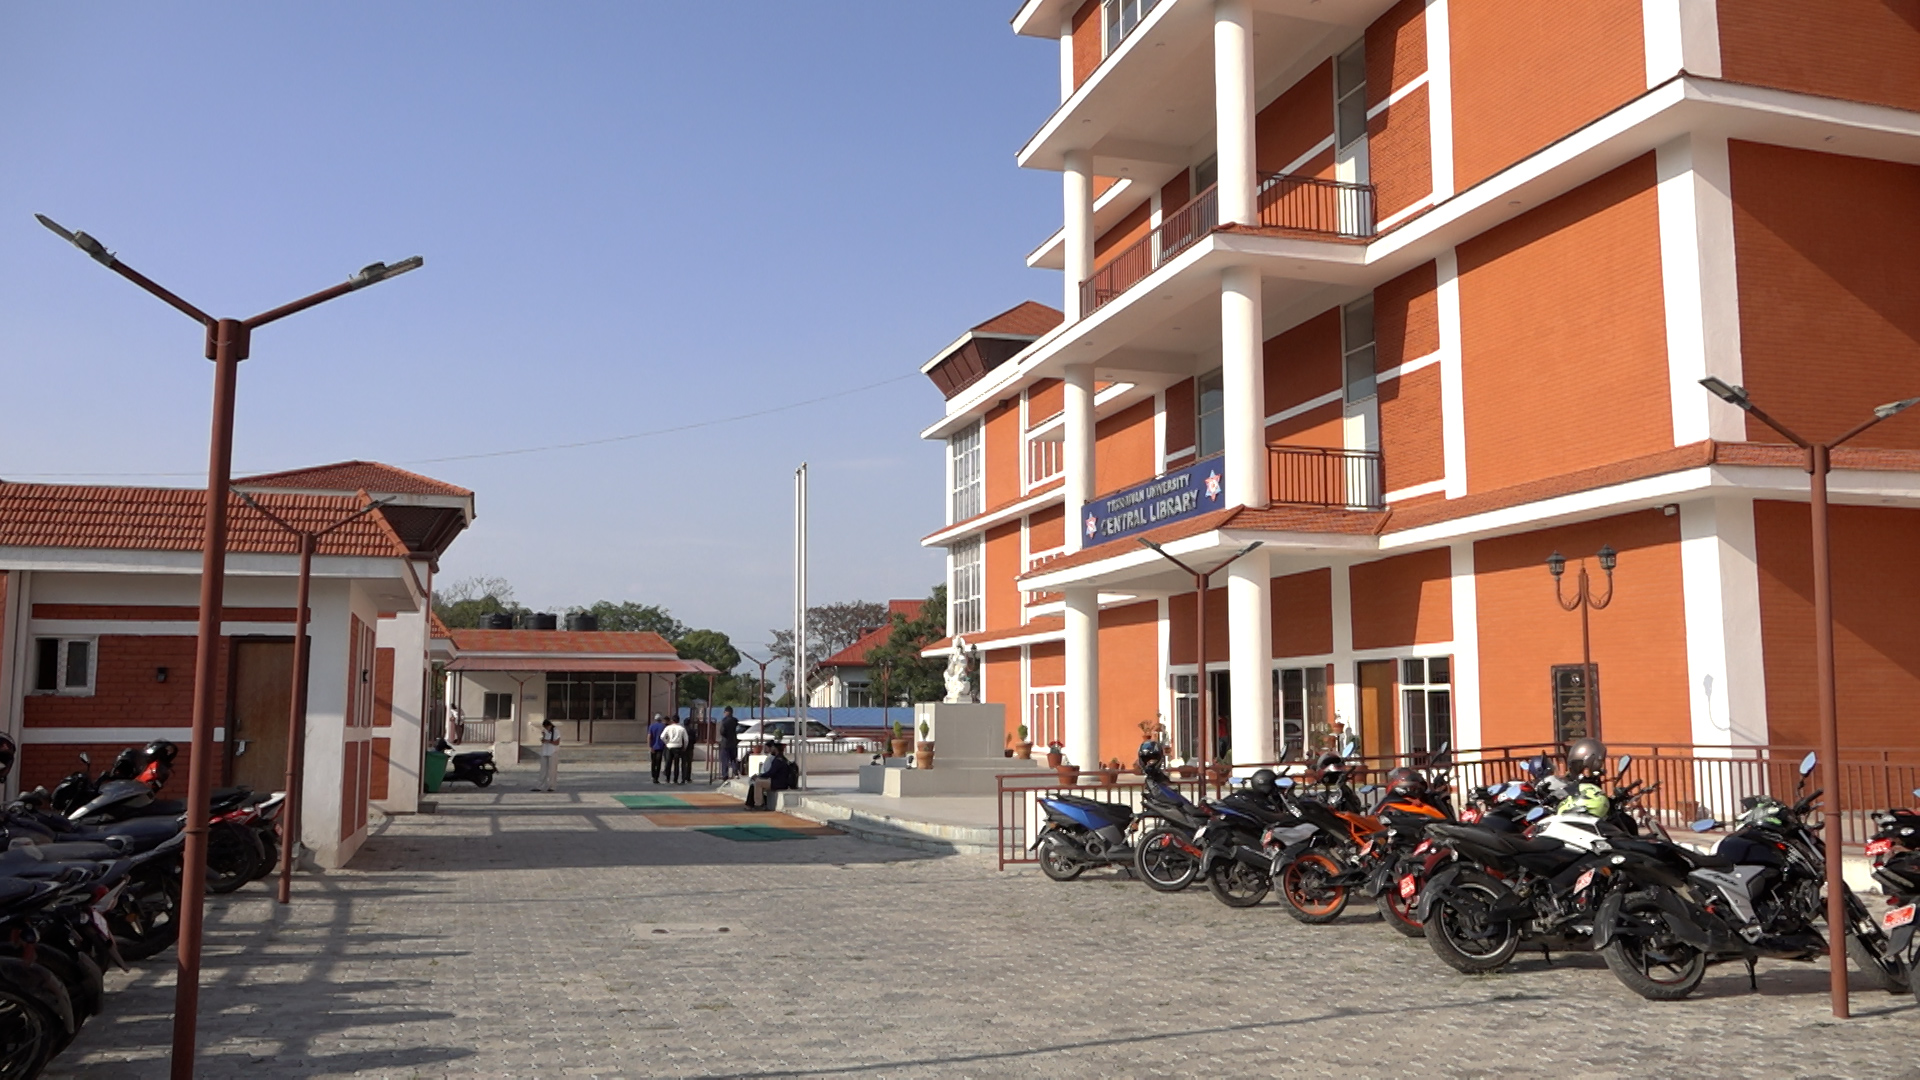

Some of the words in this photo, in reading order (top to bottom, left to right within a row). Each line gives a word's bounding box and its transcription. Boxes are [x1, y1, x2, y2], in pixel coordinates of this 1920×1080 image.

[1146, 473, 1190, 498] UNIVERSITY
[1101, 508, 1147, 536] CENTRAL
[1149, 489, 1198, 522] LIBRARY
